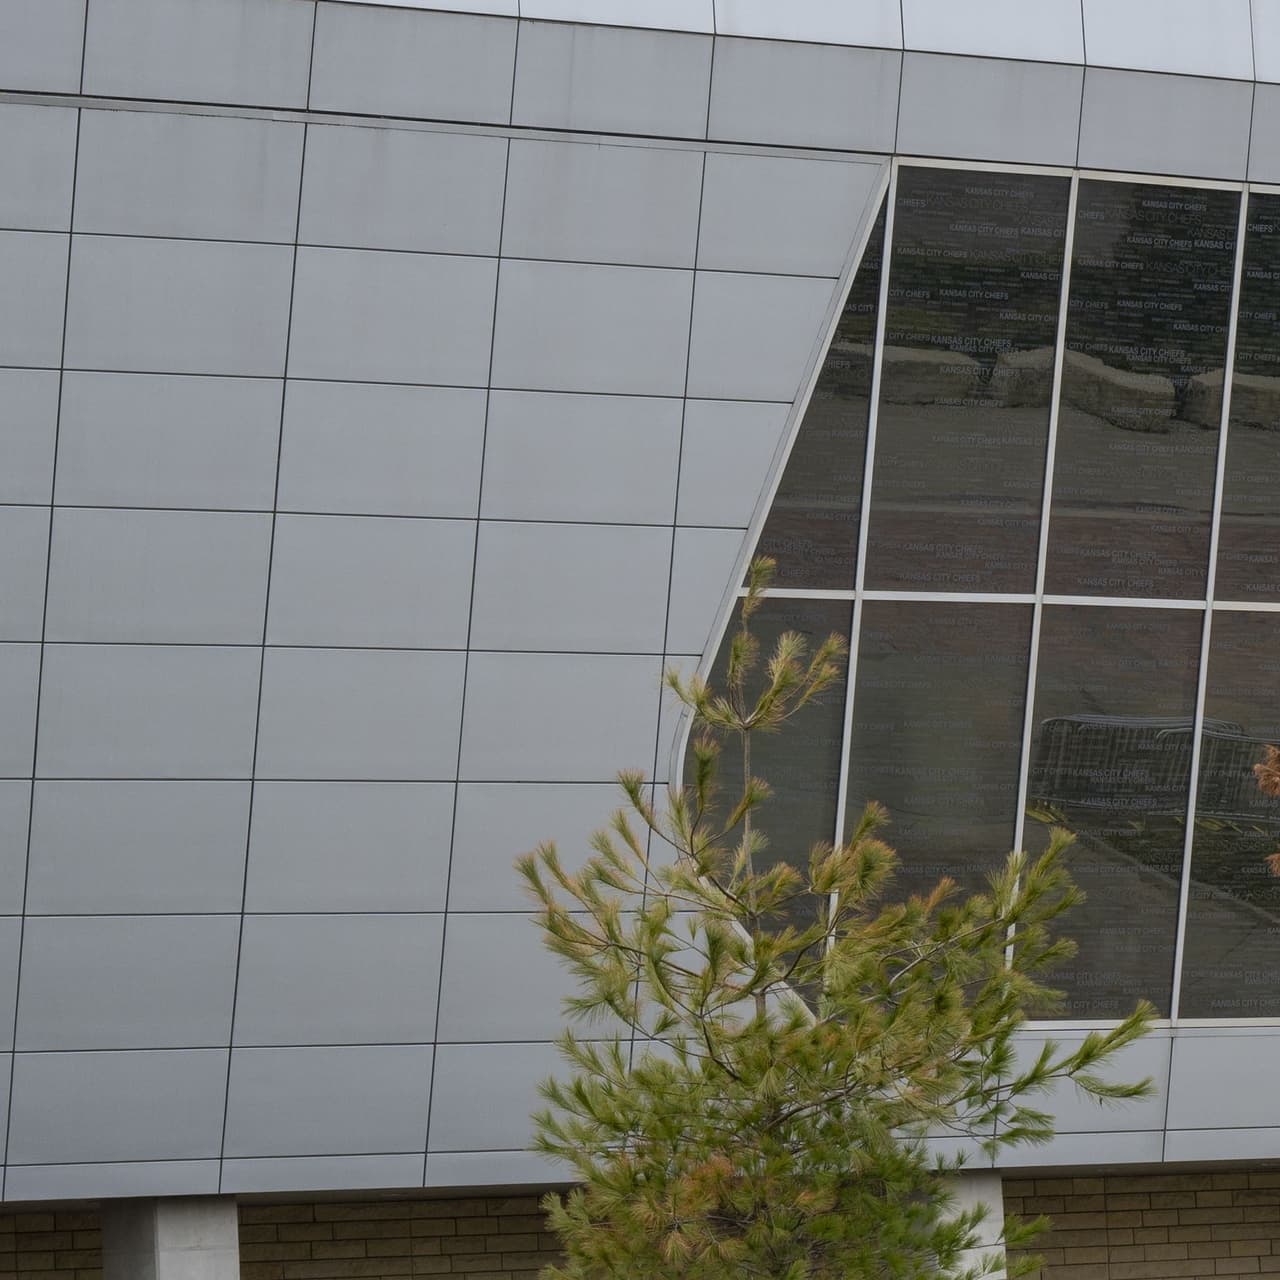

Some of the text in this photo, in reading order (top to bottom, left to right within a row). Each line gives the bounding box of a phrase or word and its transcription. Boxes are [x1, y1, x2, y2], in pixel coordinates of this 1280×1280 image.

[1247, 223, 1273, 233] CHIEFS
[1247, 271, 1272, 279] KANSAS
[939, 289, 1009, 300] KANSAS CITY CHIEFS
[1117, 300, 1183, 312] KANSAS CITY CHIEFS
